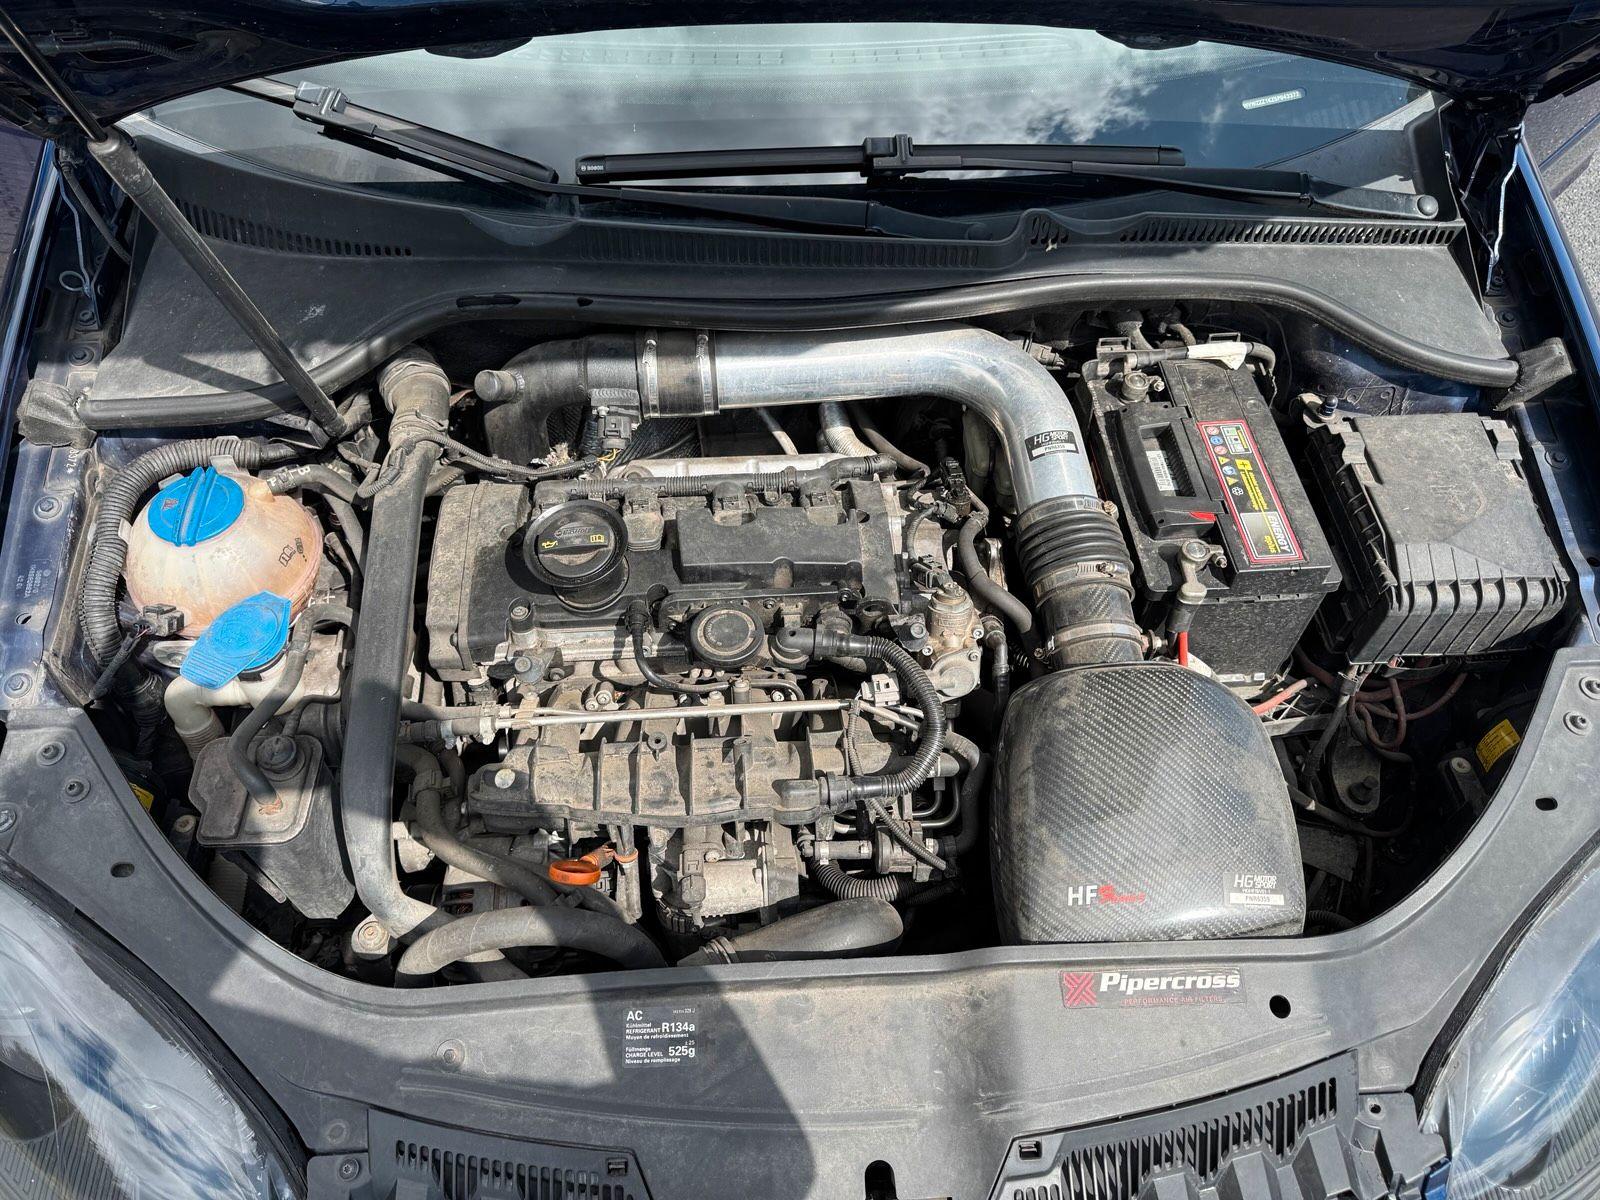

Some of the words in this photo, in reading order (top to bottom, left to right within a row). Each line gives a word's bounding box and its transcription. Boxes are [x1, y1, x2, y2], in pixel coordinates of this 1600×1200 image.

[1034, 433, 1049, 445] HG
[1267, 515, 1291, 553] ENERGY
[1233, 874, 1254, 888] HG
[1255, 881, 1277, 889] SPORT
[1067, 885, 1098, 906] HF
[1100, 972, 1241, 995] Pipercross
[626, 1010, 643, 1021] AC
[661, 1022, 696, 1033] R134a
[668, 1046, 696, 1058] 525g
